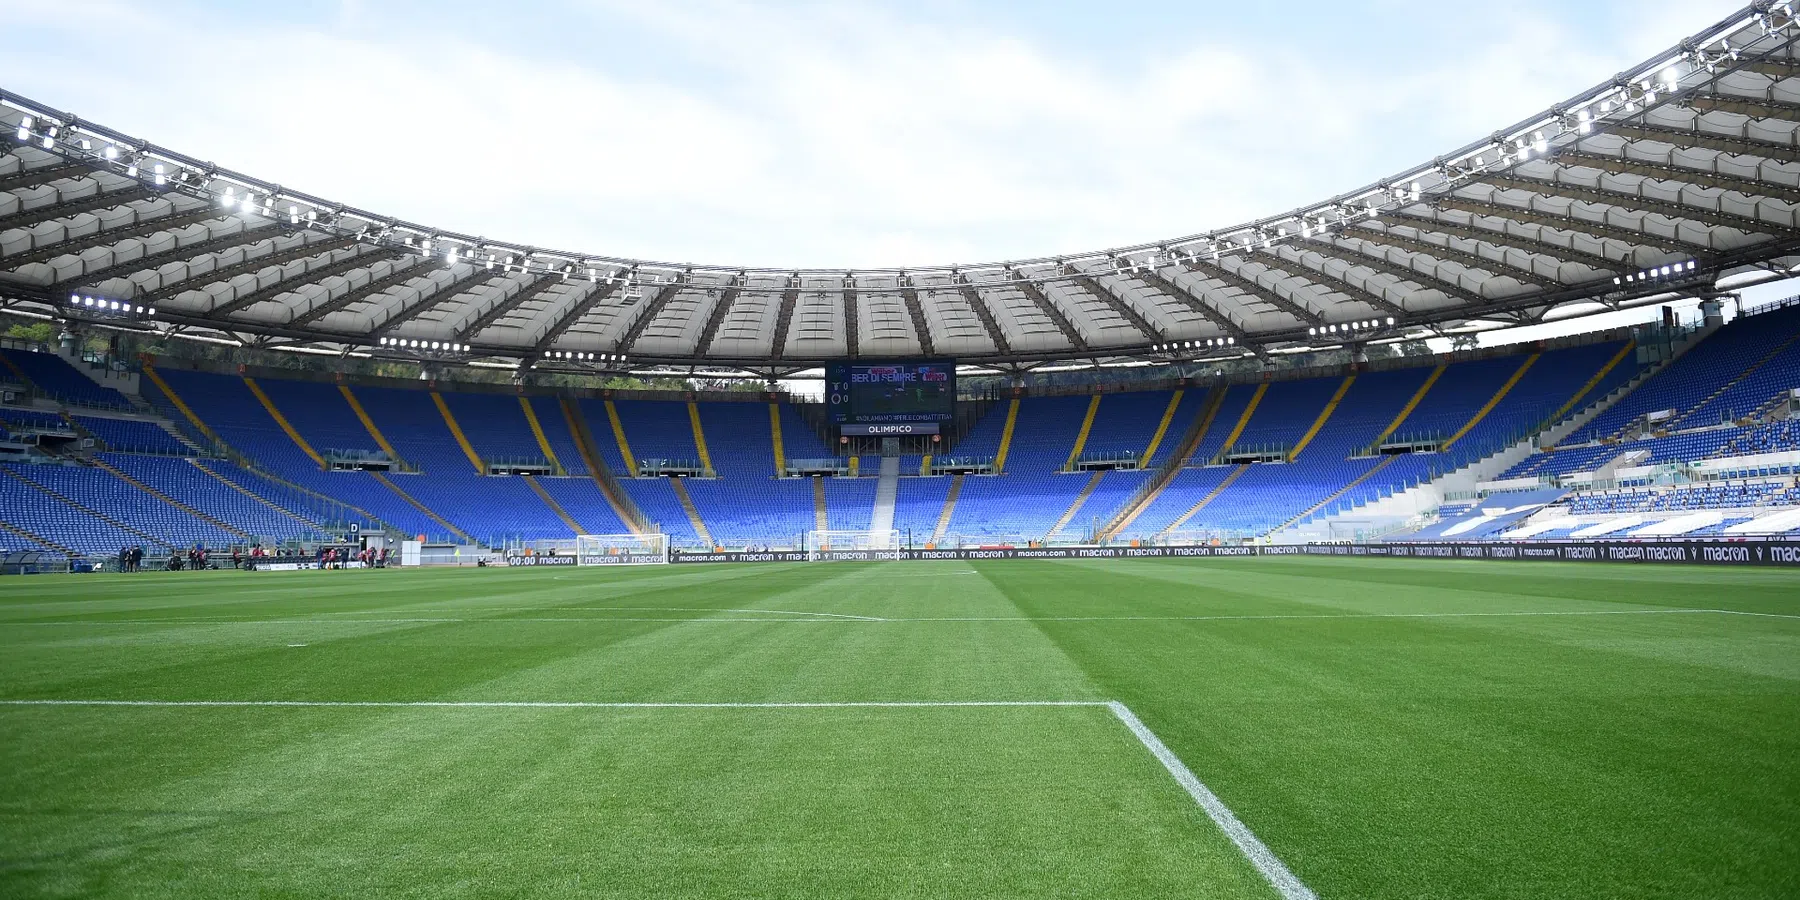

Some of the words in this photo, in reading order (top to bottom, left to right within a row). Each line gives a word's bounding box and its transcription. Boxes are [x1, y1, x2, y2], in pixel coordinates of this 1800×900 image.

[852, 374, 868, 383] BER
[871, 374, 880, 382] DI
[881, 372, 917, 382] SEMPRE
[843, 382, 849, 391] 0
[843, 394, 849, 403] 0
[868, 425, 912, 433] OLIMPICO
[351, 524, 359, 533] D
[510, 556, 536, 566] 00:00
[539, 556, 573, 565] macron
[585, 554, 620, 564] macron
[740, 553, 774, 562] macron
[833, 551, 867, 560] macron
[922, 550, 957, 559] macron
[969, 550, 1004, 559] macron
[1079, 549, 1115, 557] macron
[1127, 548, 1162, 557] macron
[1174, 547, 1210, 556] macron
[1215, 547, 1250, 555] macron
[1265, 546, 1298, 554] macron
[1461, 546, 1483, 556] macron
[1492, 546, 1515, 557] macron
[1524, 548, 1555, 556] macron.com
[1565, 546, 1596, 559] macron
[1609, 546, 1643, 559] macron
[1646, 546, 1686, 561] macron
[1704, 546, 1749, 561] macron
